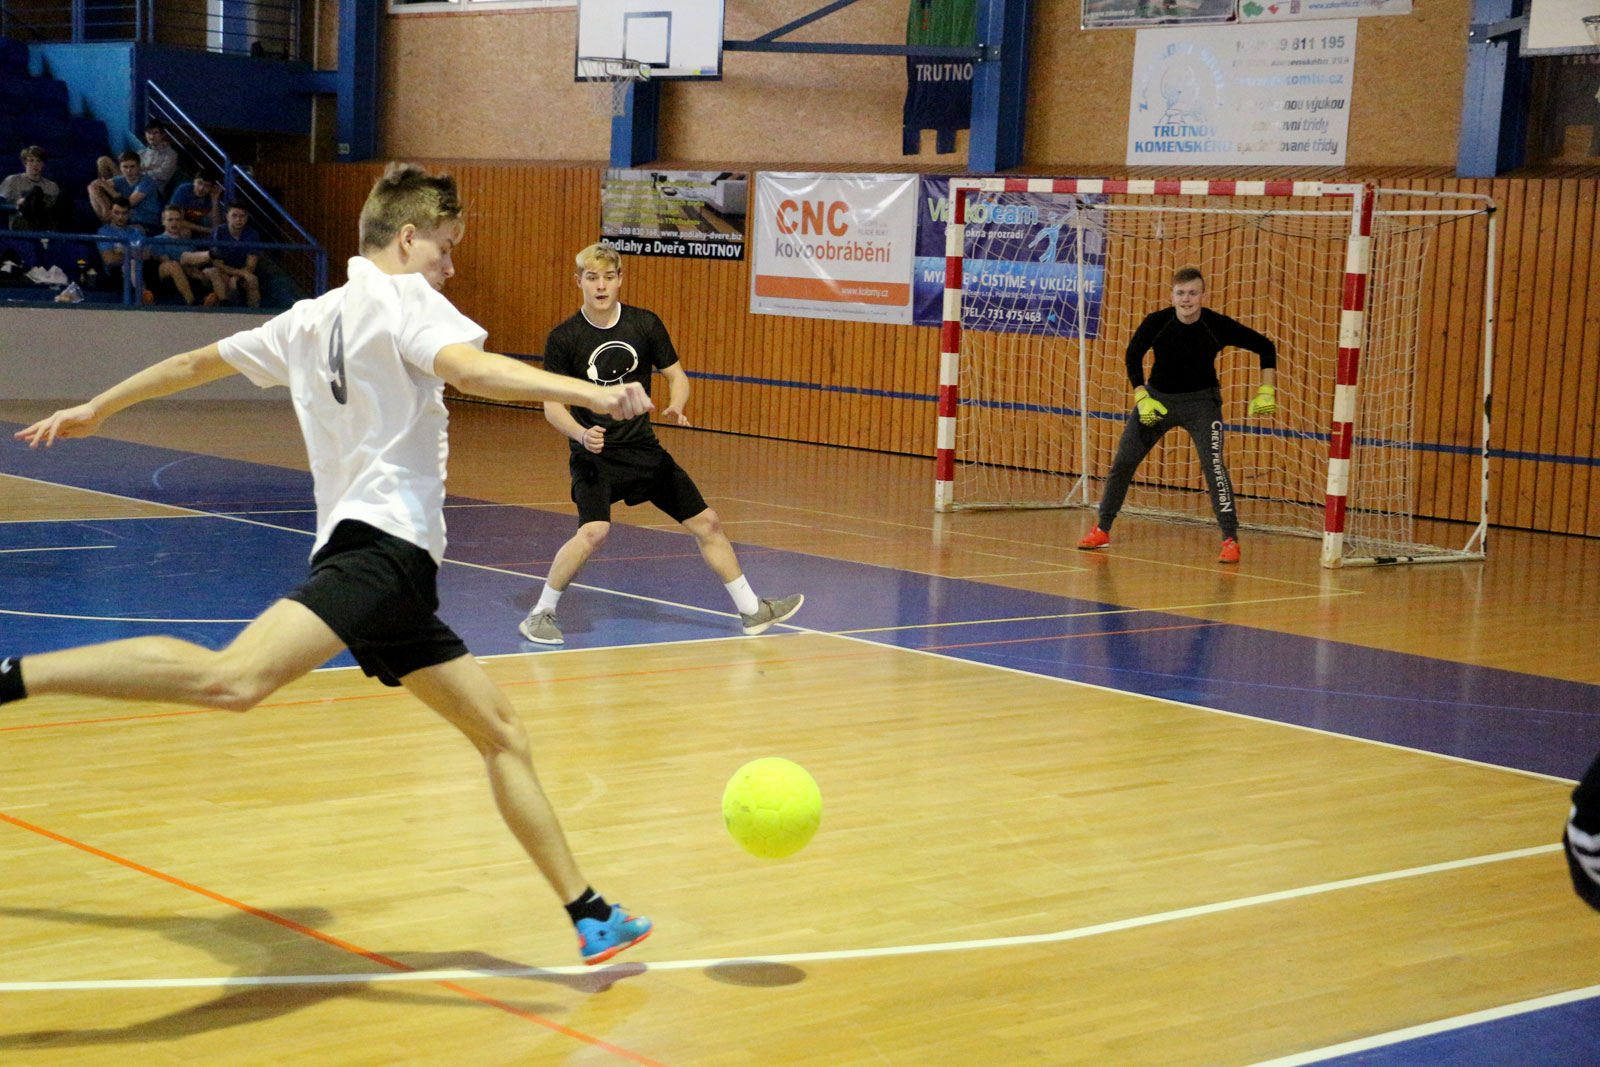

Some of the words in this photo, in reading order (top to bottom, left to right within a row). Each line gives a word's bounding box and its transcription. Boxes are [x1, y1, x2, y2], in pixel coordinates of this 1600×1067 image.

[1321, 35, 1345, 49] 195
[916, 62, 974, 82] TRUTNO
[776, 199, 849, 237] CNC
[965, 228, 986, 238] okna
[602, 238, 643, 255] Podlahy
[644, 243, 652, 253] a
[653, 240, 686, 255] Dveře
[687, 242, 742, 258] TRUTNOV
[775, 238, 892, 263] kovoobrábění
[923, 269, 974, 286] MYJE
[988, 308, 1004, 320] 731
[1005, 309, 1024, 321] 475
[1024, 310, 1042, 323] 463
[1211, 420, 1223, 450] CREW
